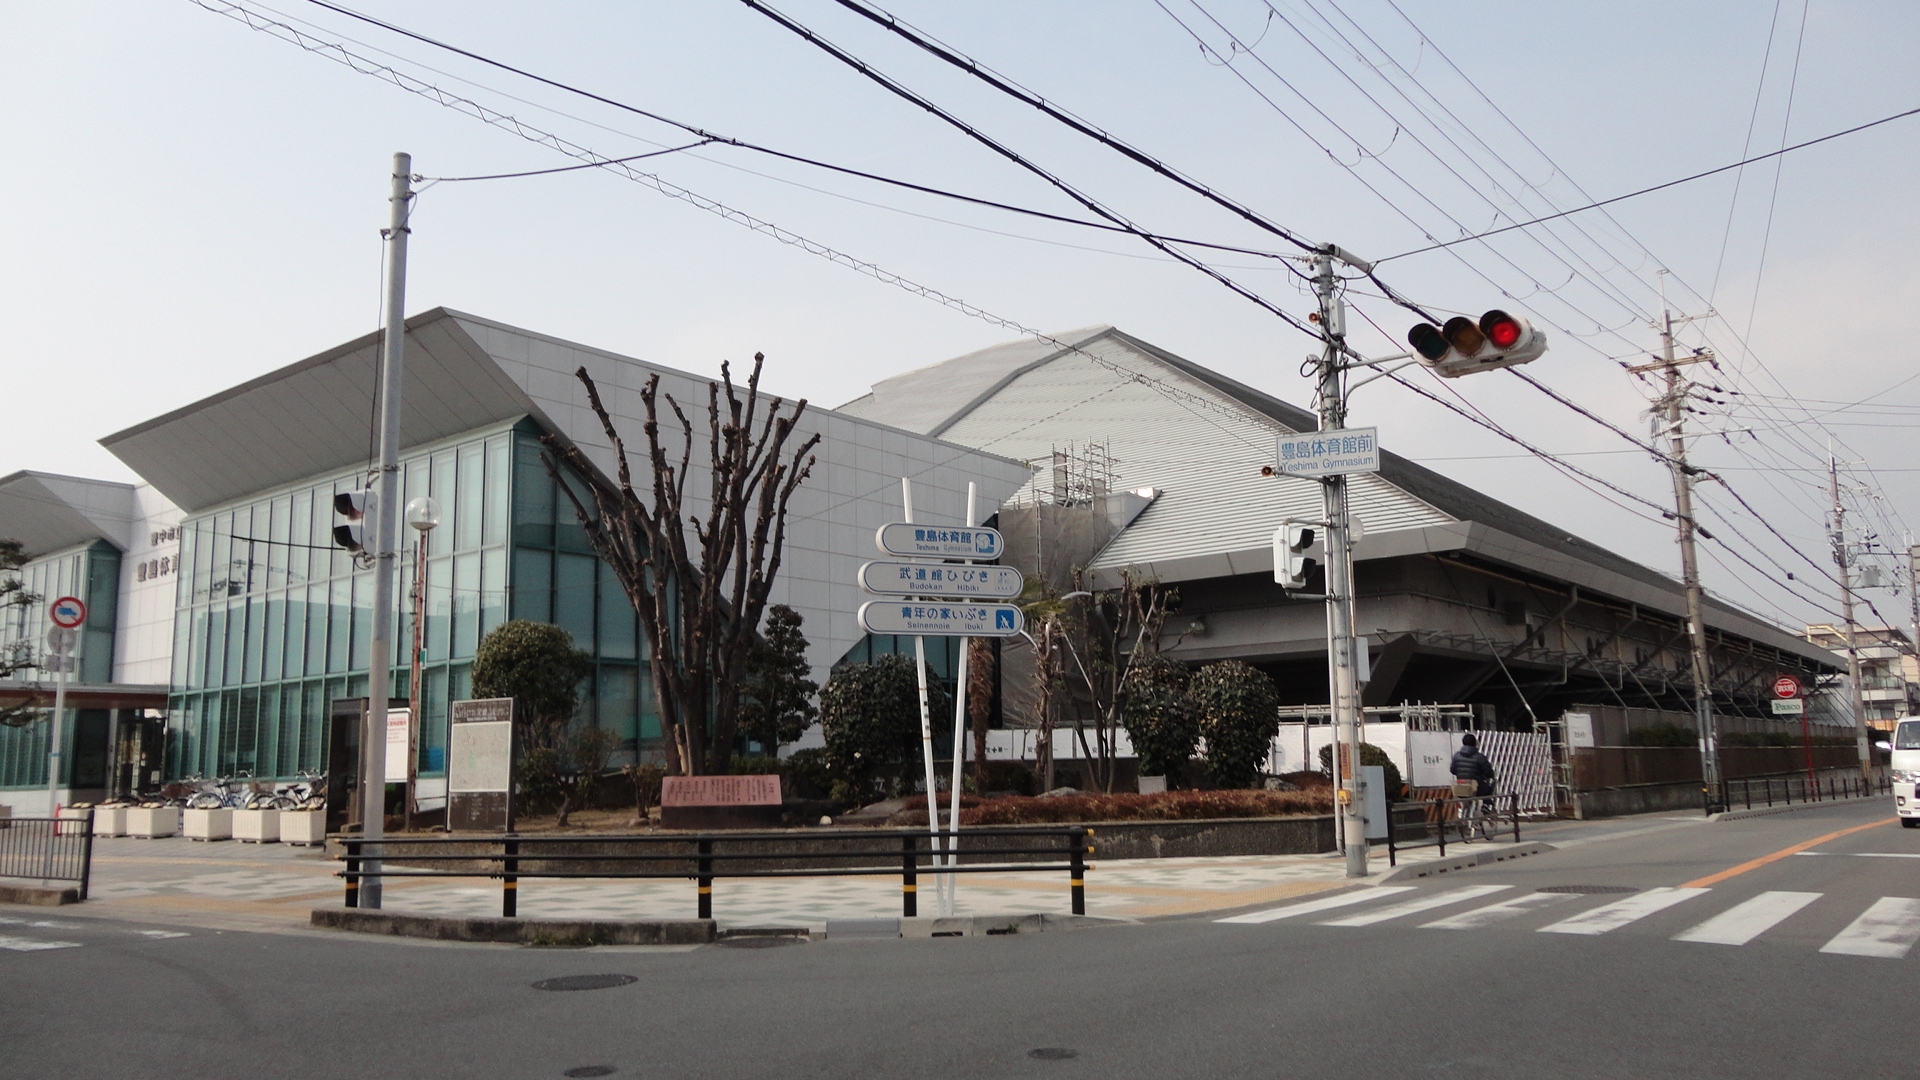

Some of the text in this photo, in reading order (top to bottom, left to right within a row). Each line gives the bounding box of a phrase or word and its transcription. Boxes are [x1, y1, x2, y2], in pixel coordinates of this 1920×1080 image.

[1281, 434, 1373, 460] 豊島体育館前
[1282, 456, 1374, 472] Teshima Gymnasium
[914, 529, 972, 544] 豊島体育館
[916, 543, 939, 551] Teshima
[909, 582, 943, 590] Budokan
[901, 606, 988, 621] 青年の家いぶき
[907, 621, 983, 630] Seinennoie Ibuki
[1774, 702, 1801, 711] Pasco
